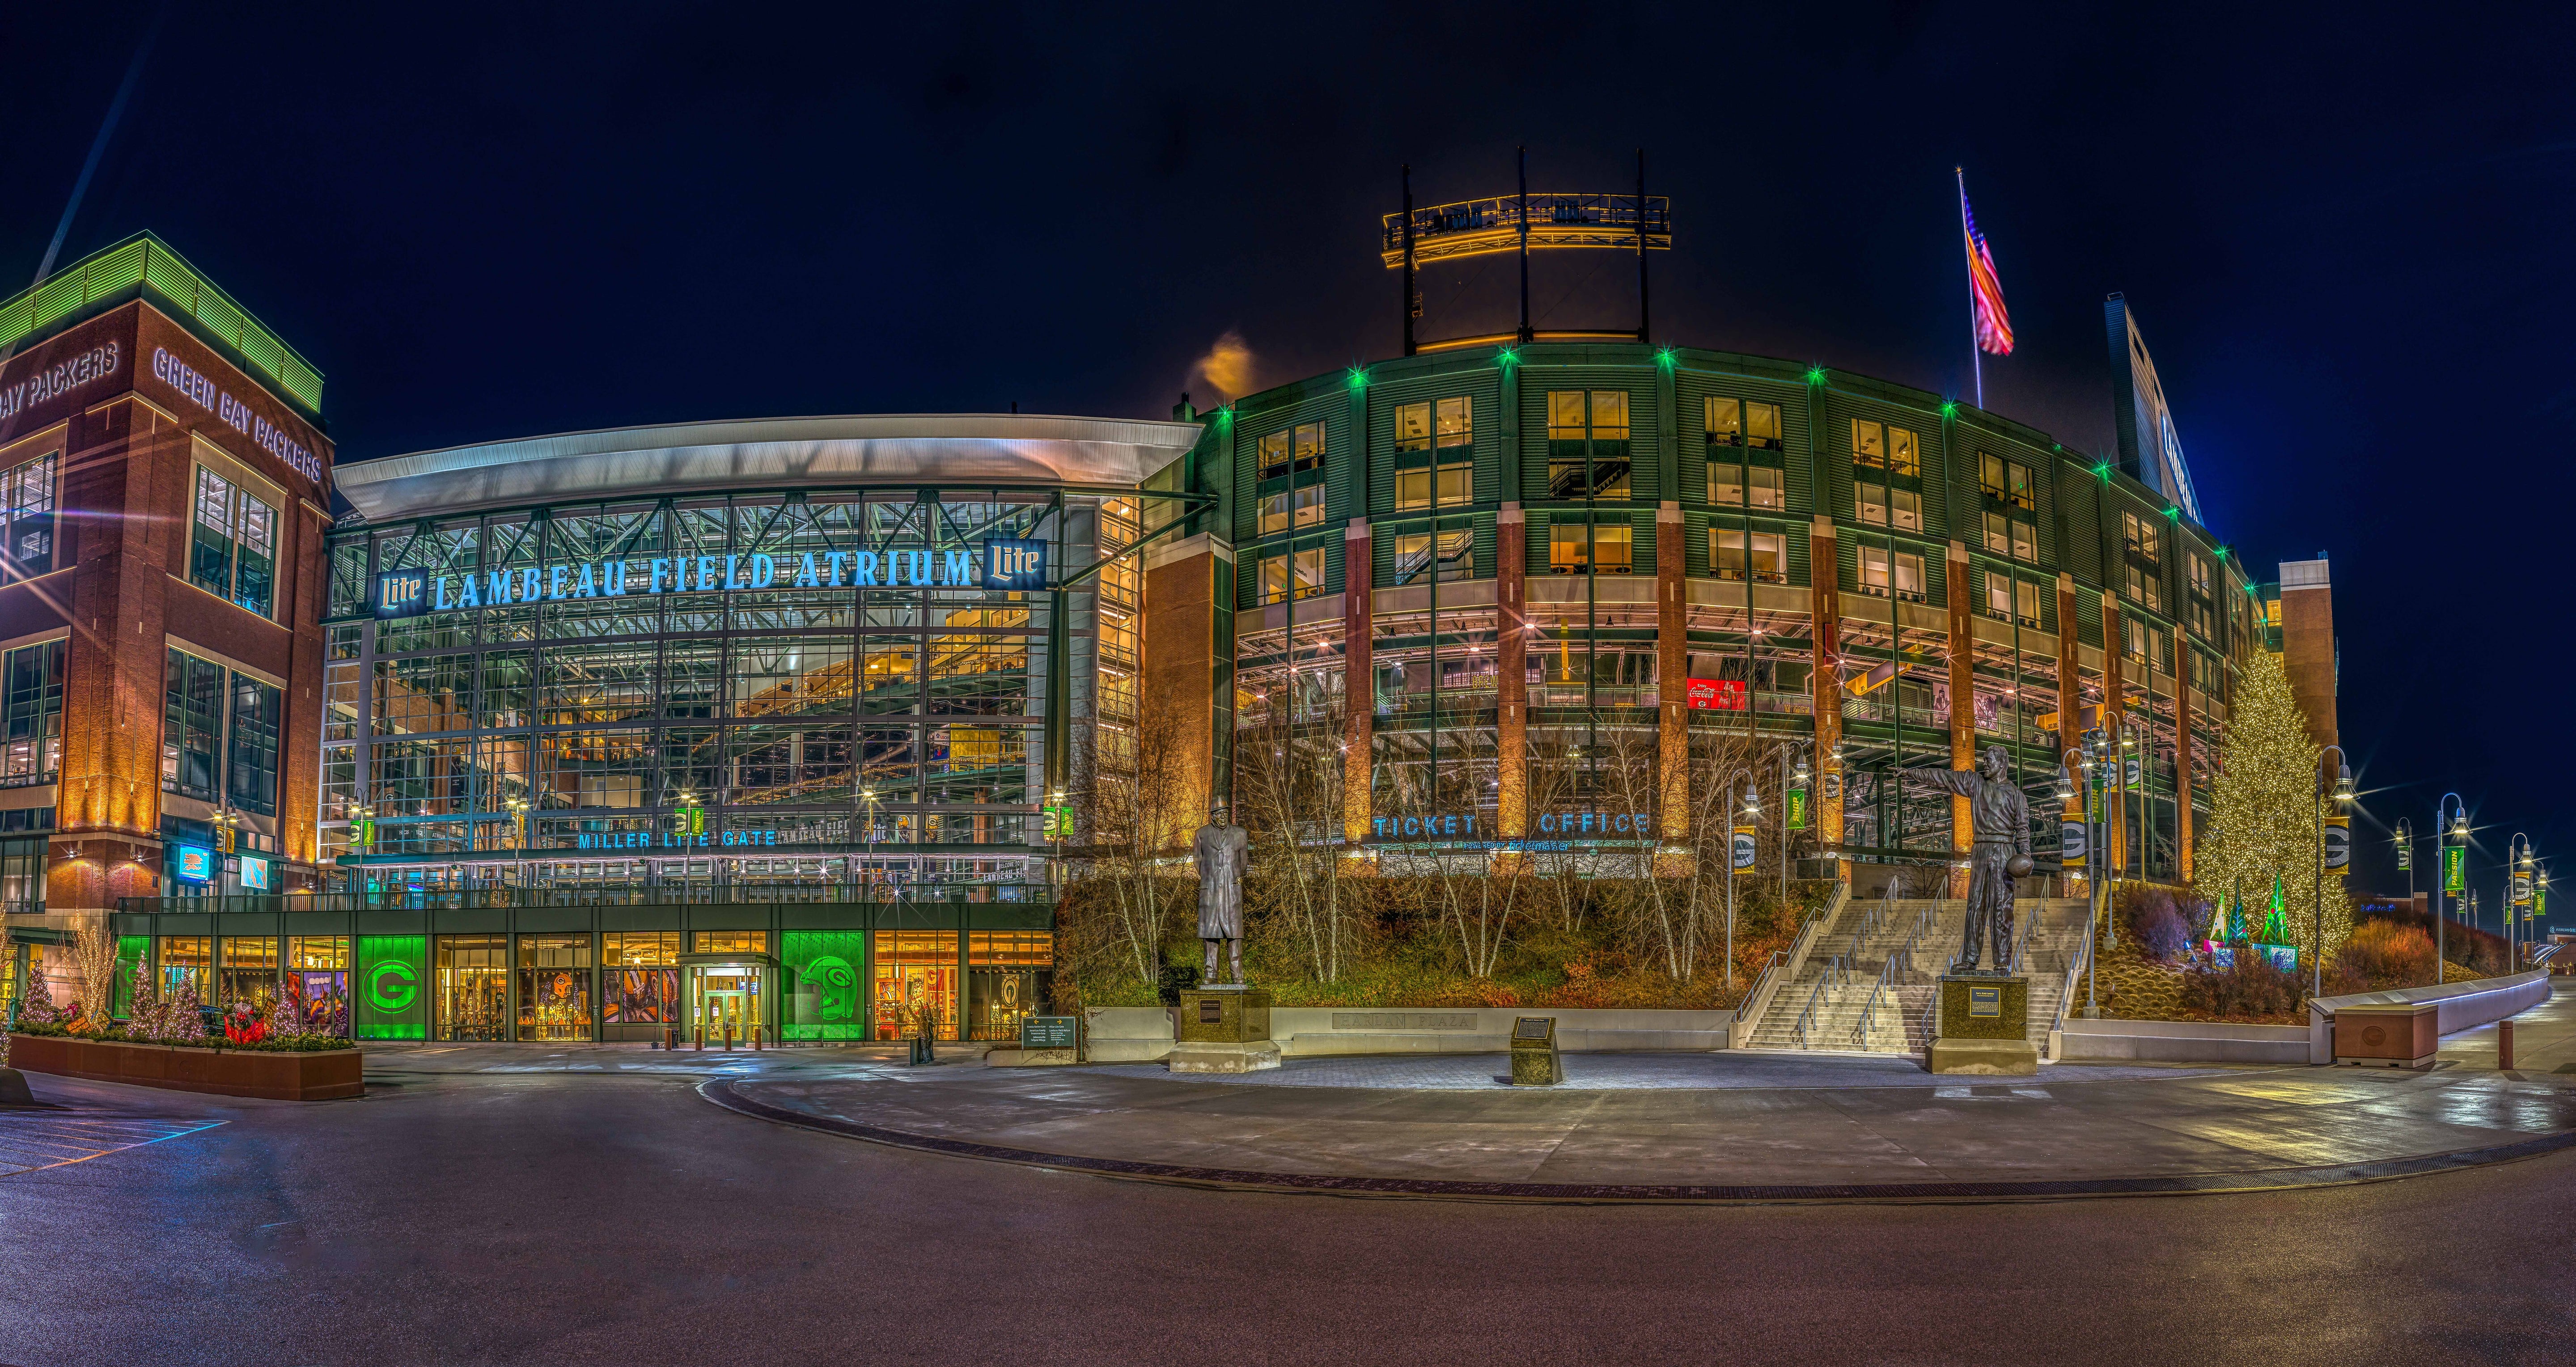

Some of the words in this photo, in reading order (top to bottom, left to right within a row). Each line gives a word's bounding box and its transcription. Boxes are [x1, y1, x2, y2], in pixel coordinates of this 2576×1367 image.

[0, 383, 24, 418] AY
[29, 343, 118, 405] PACKERS
[154, 347, 216, 411] GREEN
[220, 392, 253, 436] BAY
[255, 415, 322, 483] PACKERS
[435, 561, 626, 610] LAMBEAU
[650, 553, 775, 593] FIELD
[796, 550, 972, 587] ATRIUM
[991, 546, 1039, 581] Lite
[381, 577, 421, 611] Lite
[1473, 675, 1498, 688] BREW
[579, 833, 650, 849] MILLER
[723, 830, 776, 846] GATE
[1374, 815, 1475, 836] TICKET
[1541, 813, 1648, 833] OFFICE
[1341, 1016, 1404, 1026] HARLAN
[1419, 1016, 1469, 1027] PLAZA
